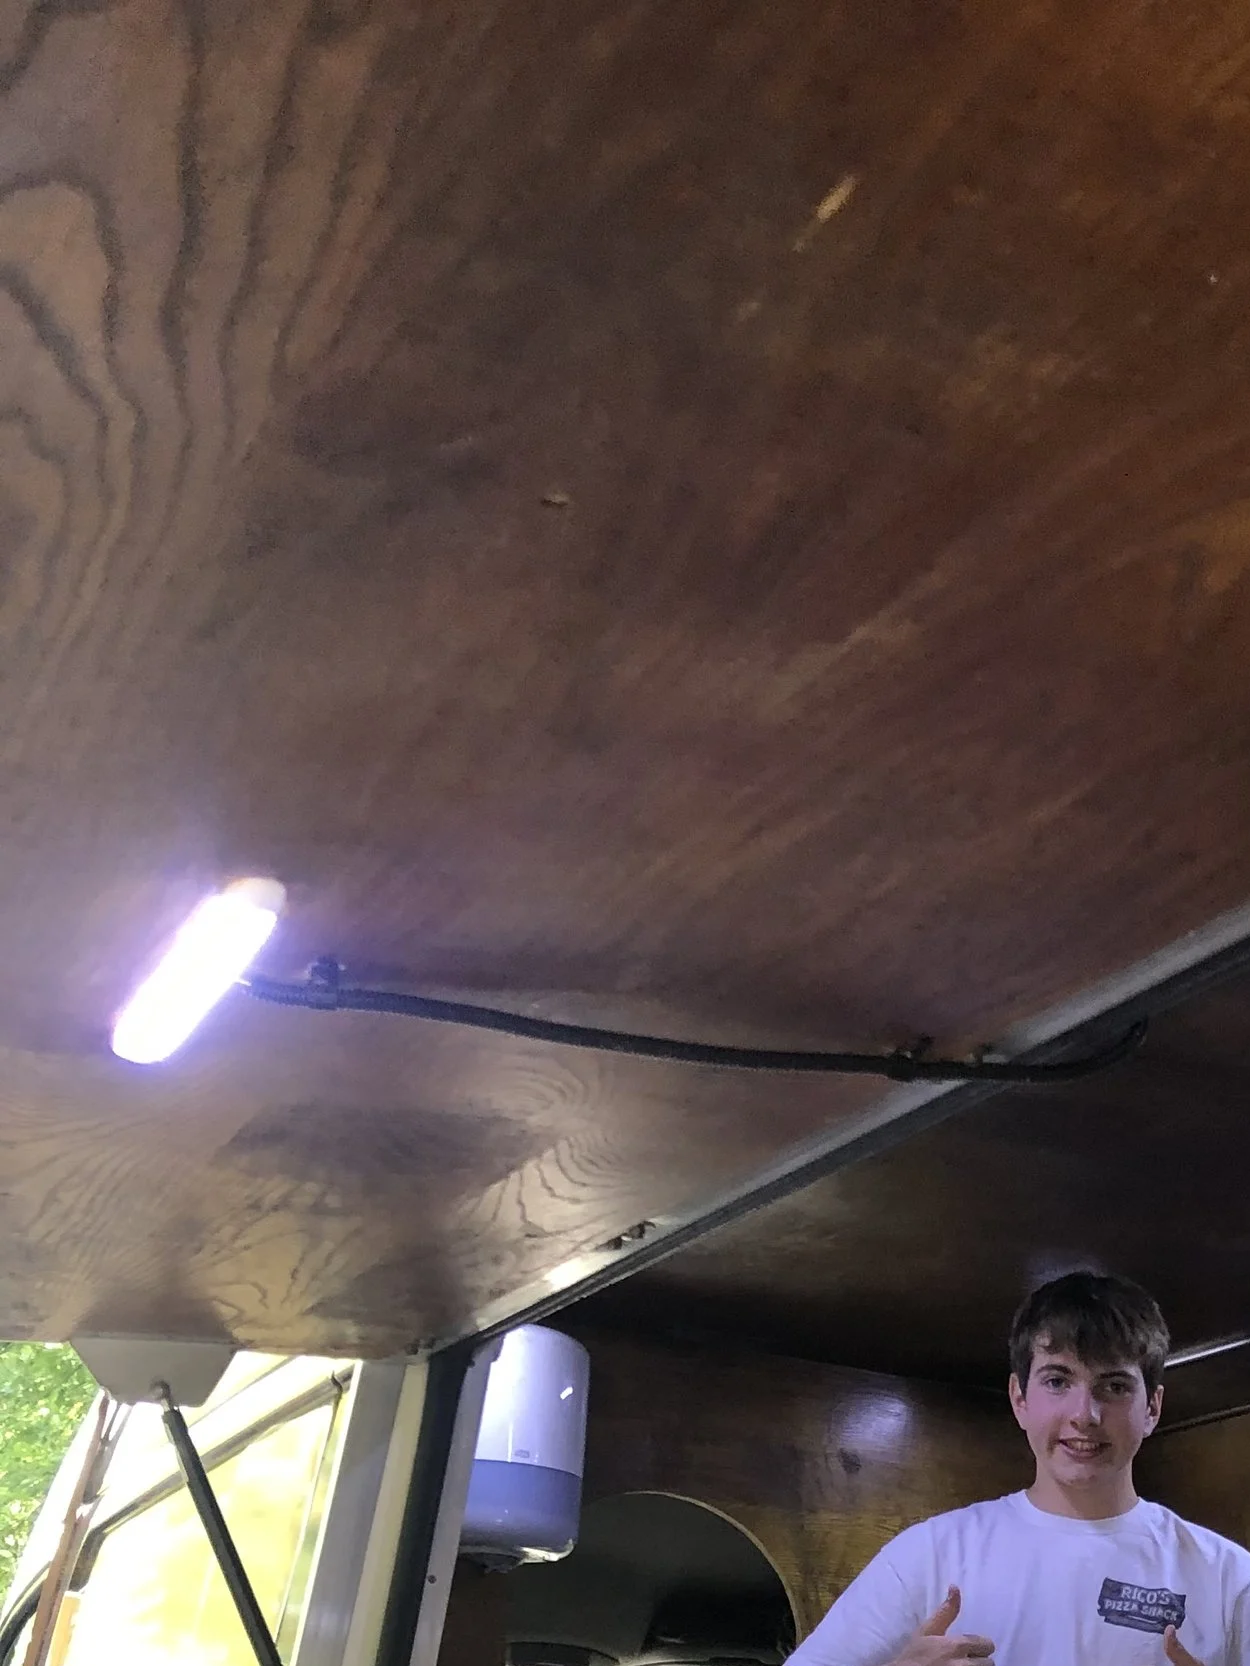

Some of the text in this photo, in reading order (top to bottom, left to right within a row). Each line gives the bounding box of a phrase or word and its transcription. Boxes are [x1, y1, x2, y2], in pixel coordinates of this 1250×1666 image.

[1121, 1585, 1171, 1606] RICO'S
[1104, 1599, 1178, 1622] PIZZA SHACK
